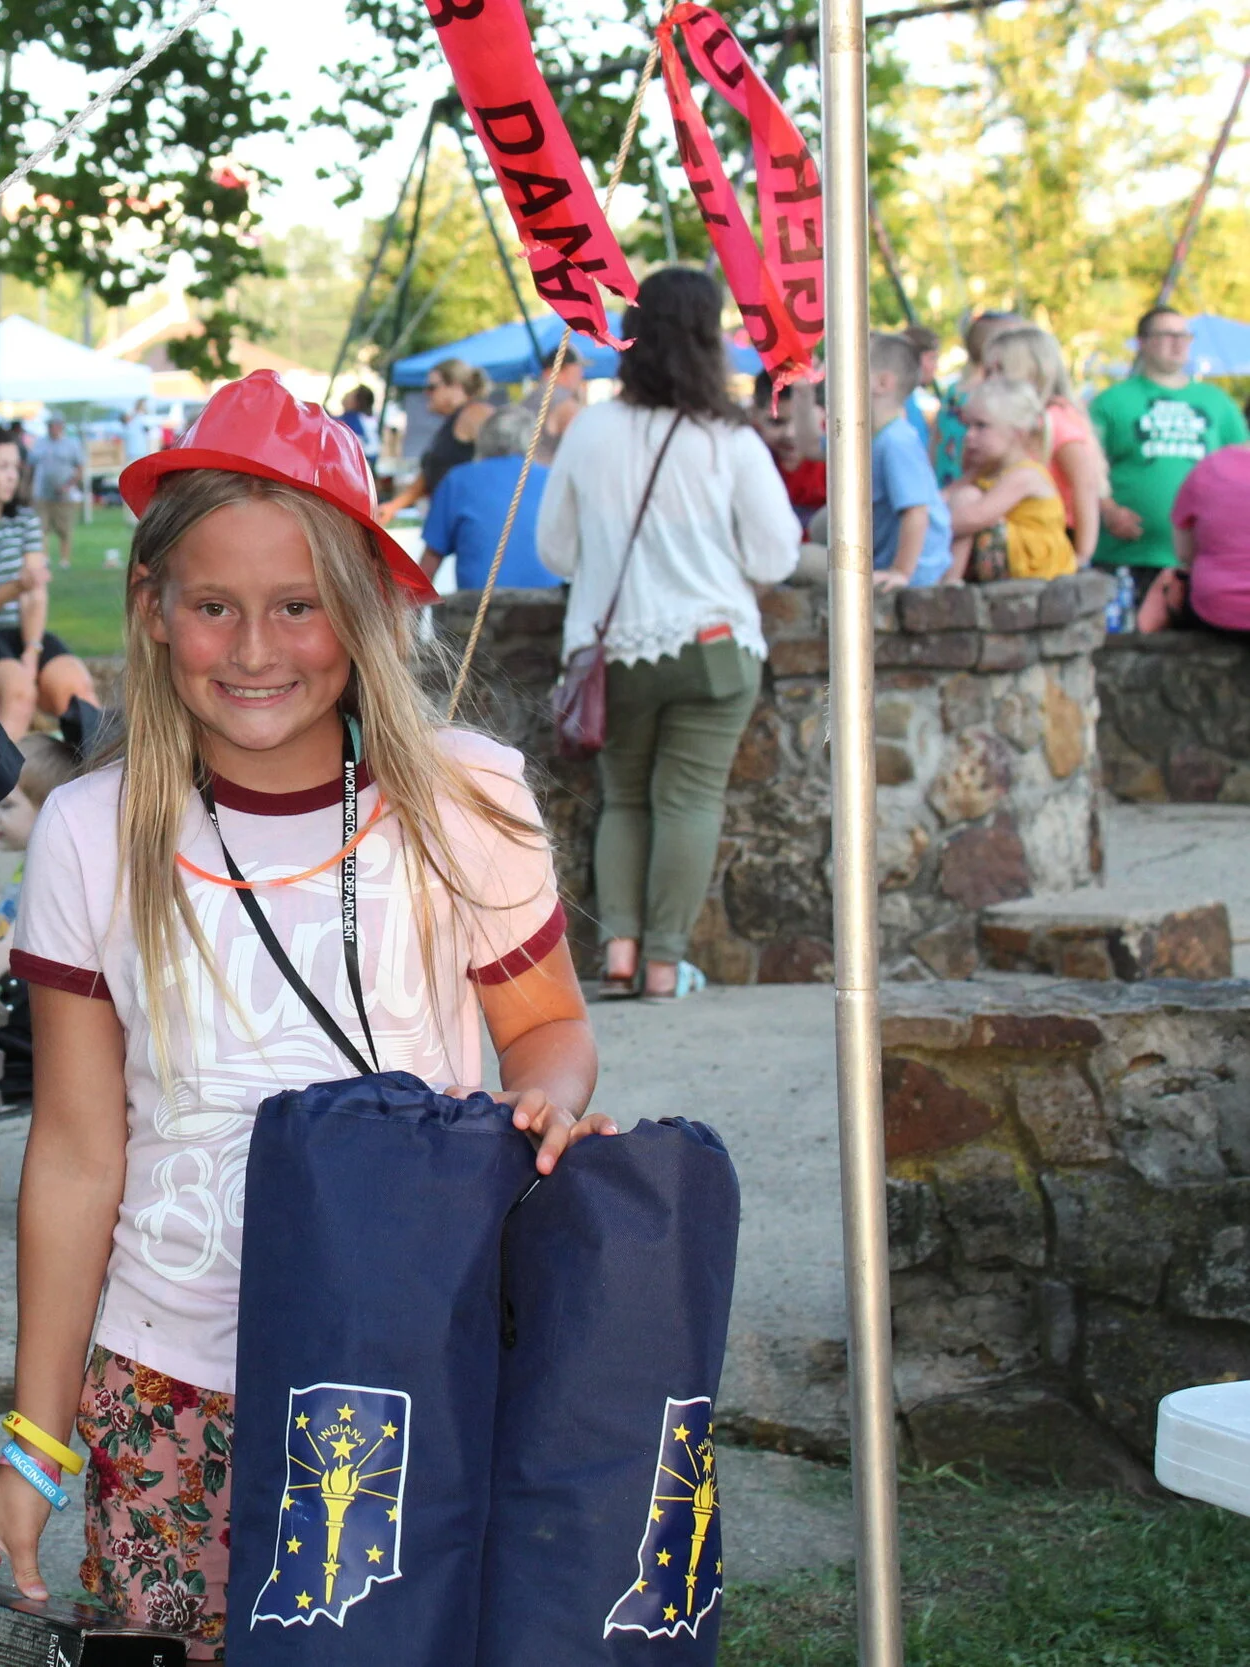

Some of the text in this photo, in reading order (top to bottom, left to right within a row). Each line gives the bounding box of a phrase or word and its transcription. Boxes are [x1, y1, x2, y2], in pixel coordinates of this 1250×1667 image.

[344, 768, 355, 942] WORTHINGTON OLICE DEPARTMENT
[317, 1423, 366, 1447] INDIANA
[10, 1451, 56, 1497] VACCINATED
